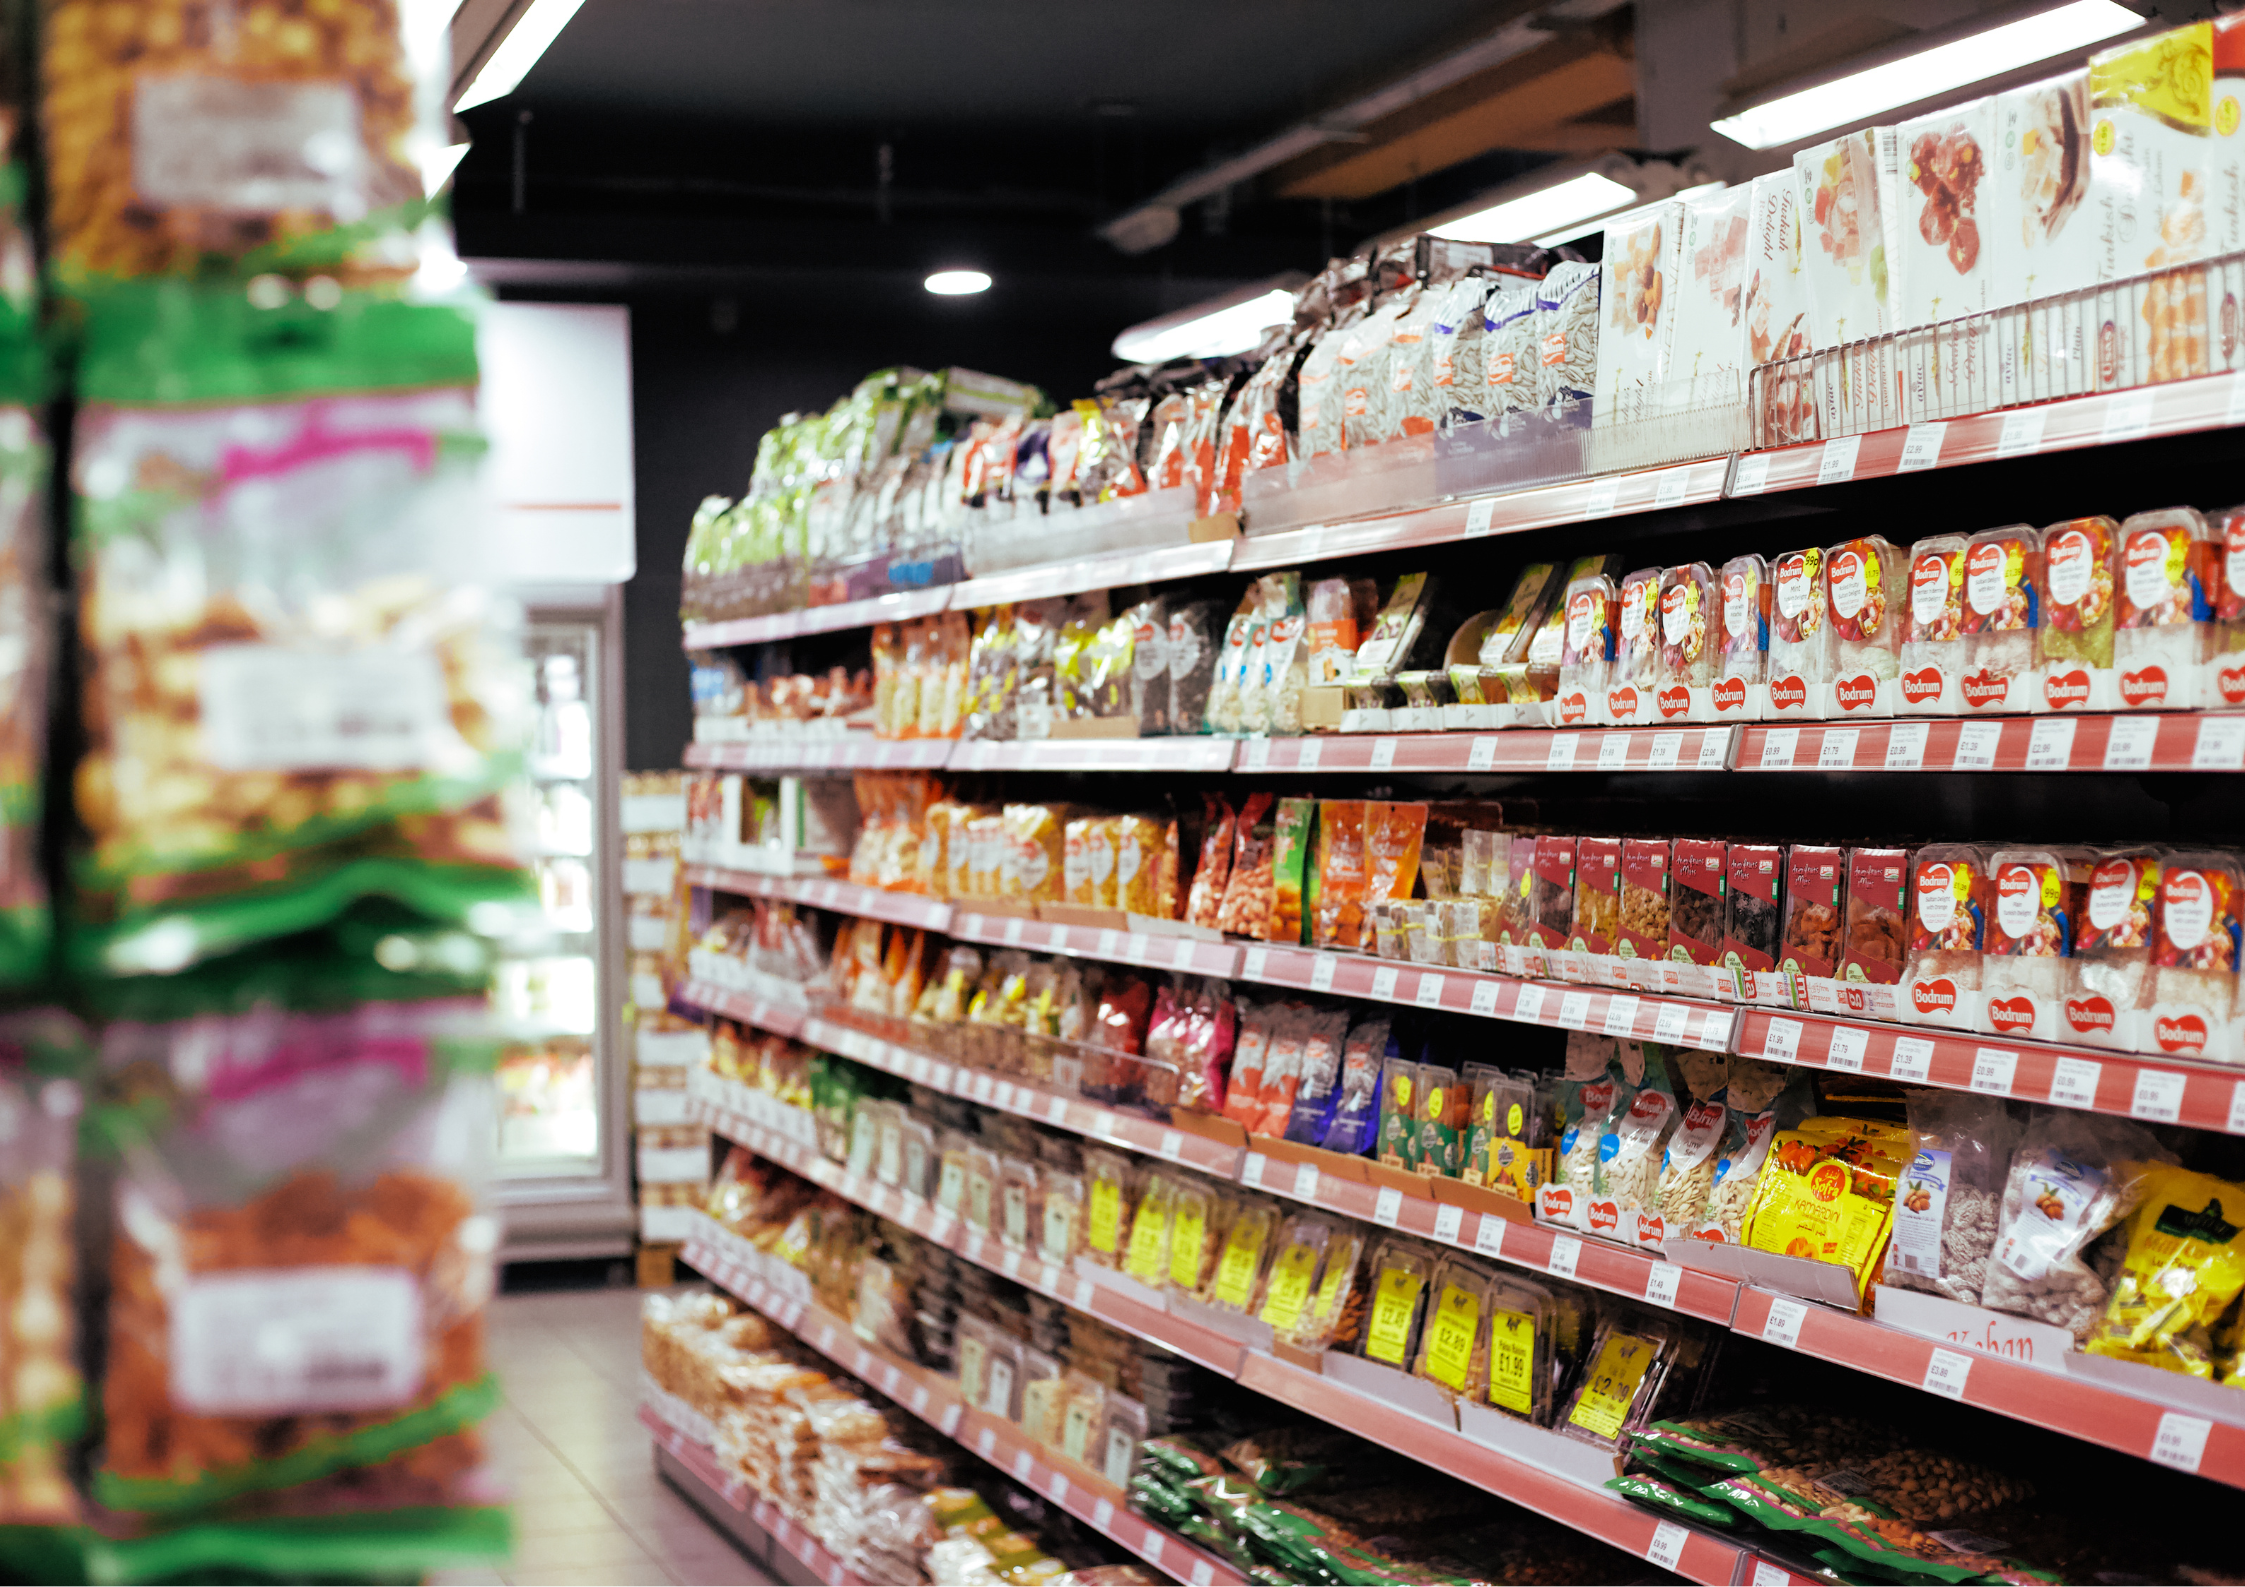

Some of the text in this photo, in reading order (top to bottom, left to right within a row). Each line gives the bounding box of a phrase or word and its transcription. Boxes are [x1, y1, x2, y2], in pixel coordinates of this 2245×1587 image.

[1777, 187, 1793, 252] Turkish
[1763, 191, 1779, 262] Delight
[1805, 555, 1818, 568] 99p
[1970, 557, 1998, 570] Bodrum
[1780, 566, 1803, 579] Bodrum
[1831, 563, 1855, 578] Bodrum
[1915, 569, 1940, 580] Bodrum
[1724, 585, 1743, 599] Bodrum
[1663, 594, 1685, 609] Bodrum
[1905, 681, 1940, 694] Bodrum
[1965, 684, 2006, 697] Bodrum
[2048, 684, 2089, 698] Bodrum
[2123, 679, 2166, 694] Bodrum
[1715, 688, 1744, 702] Bodrum
[1773, 689, 1804, 701] Bodrum
[1839, 687, 1874, 700] Bodrum
[1611, 696, 1636, 710] Bodrum
[1660, 695, 1688, 709] Bodrum
[1561, 702, 1585, 717] Bodrum
[1702, 748, 1716, 757] £2.99
[1765, 746, 1780, 755] £0.99
[1823, 746, 1839, 755] £1.79
[1890, 746, 1906, 755] £0.99
[2032, 743, 2051, 754] £2.99
[1919, 877, 1948, 887] Bodrum
[2000, 879, 2029, 890] Bodrum
[2044, 888, 2060, 901] 99p
[2166, 883, 2201, 898] Bodrum
[1915, 989, 1954, 1005] Bodrum
[1992, 1008, 2033, 1024] Bodrum
[2069, 1007, 2112, 1024] Bodrum
[1769, 1034, 1783, 1044] £1.99
[2159, 1026, 2204, 1044] Bodrum
[1833, 1043, 1848, 1053] £1.79
[1896, 1054, 1912, 1064] £1.39
[1977, 1066, 1995, 1076] £0.99
[2057, 1076, 2076, 1087] £0.99
[1811, 1175, 1840, 1198] Sofra
[1590, 1207, 1617, 1224] Bodrum
[1794, 1198, 1841, 1224] KAMARDIN
[1650, 1279, 1664, 1289] £1.49
[1769, 1315, 1786, 1328] £1.89
[1499, 1352, 1525, 1378] £1.99
[1653, 1538, 1668, 1551] £9.99
